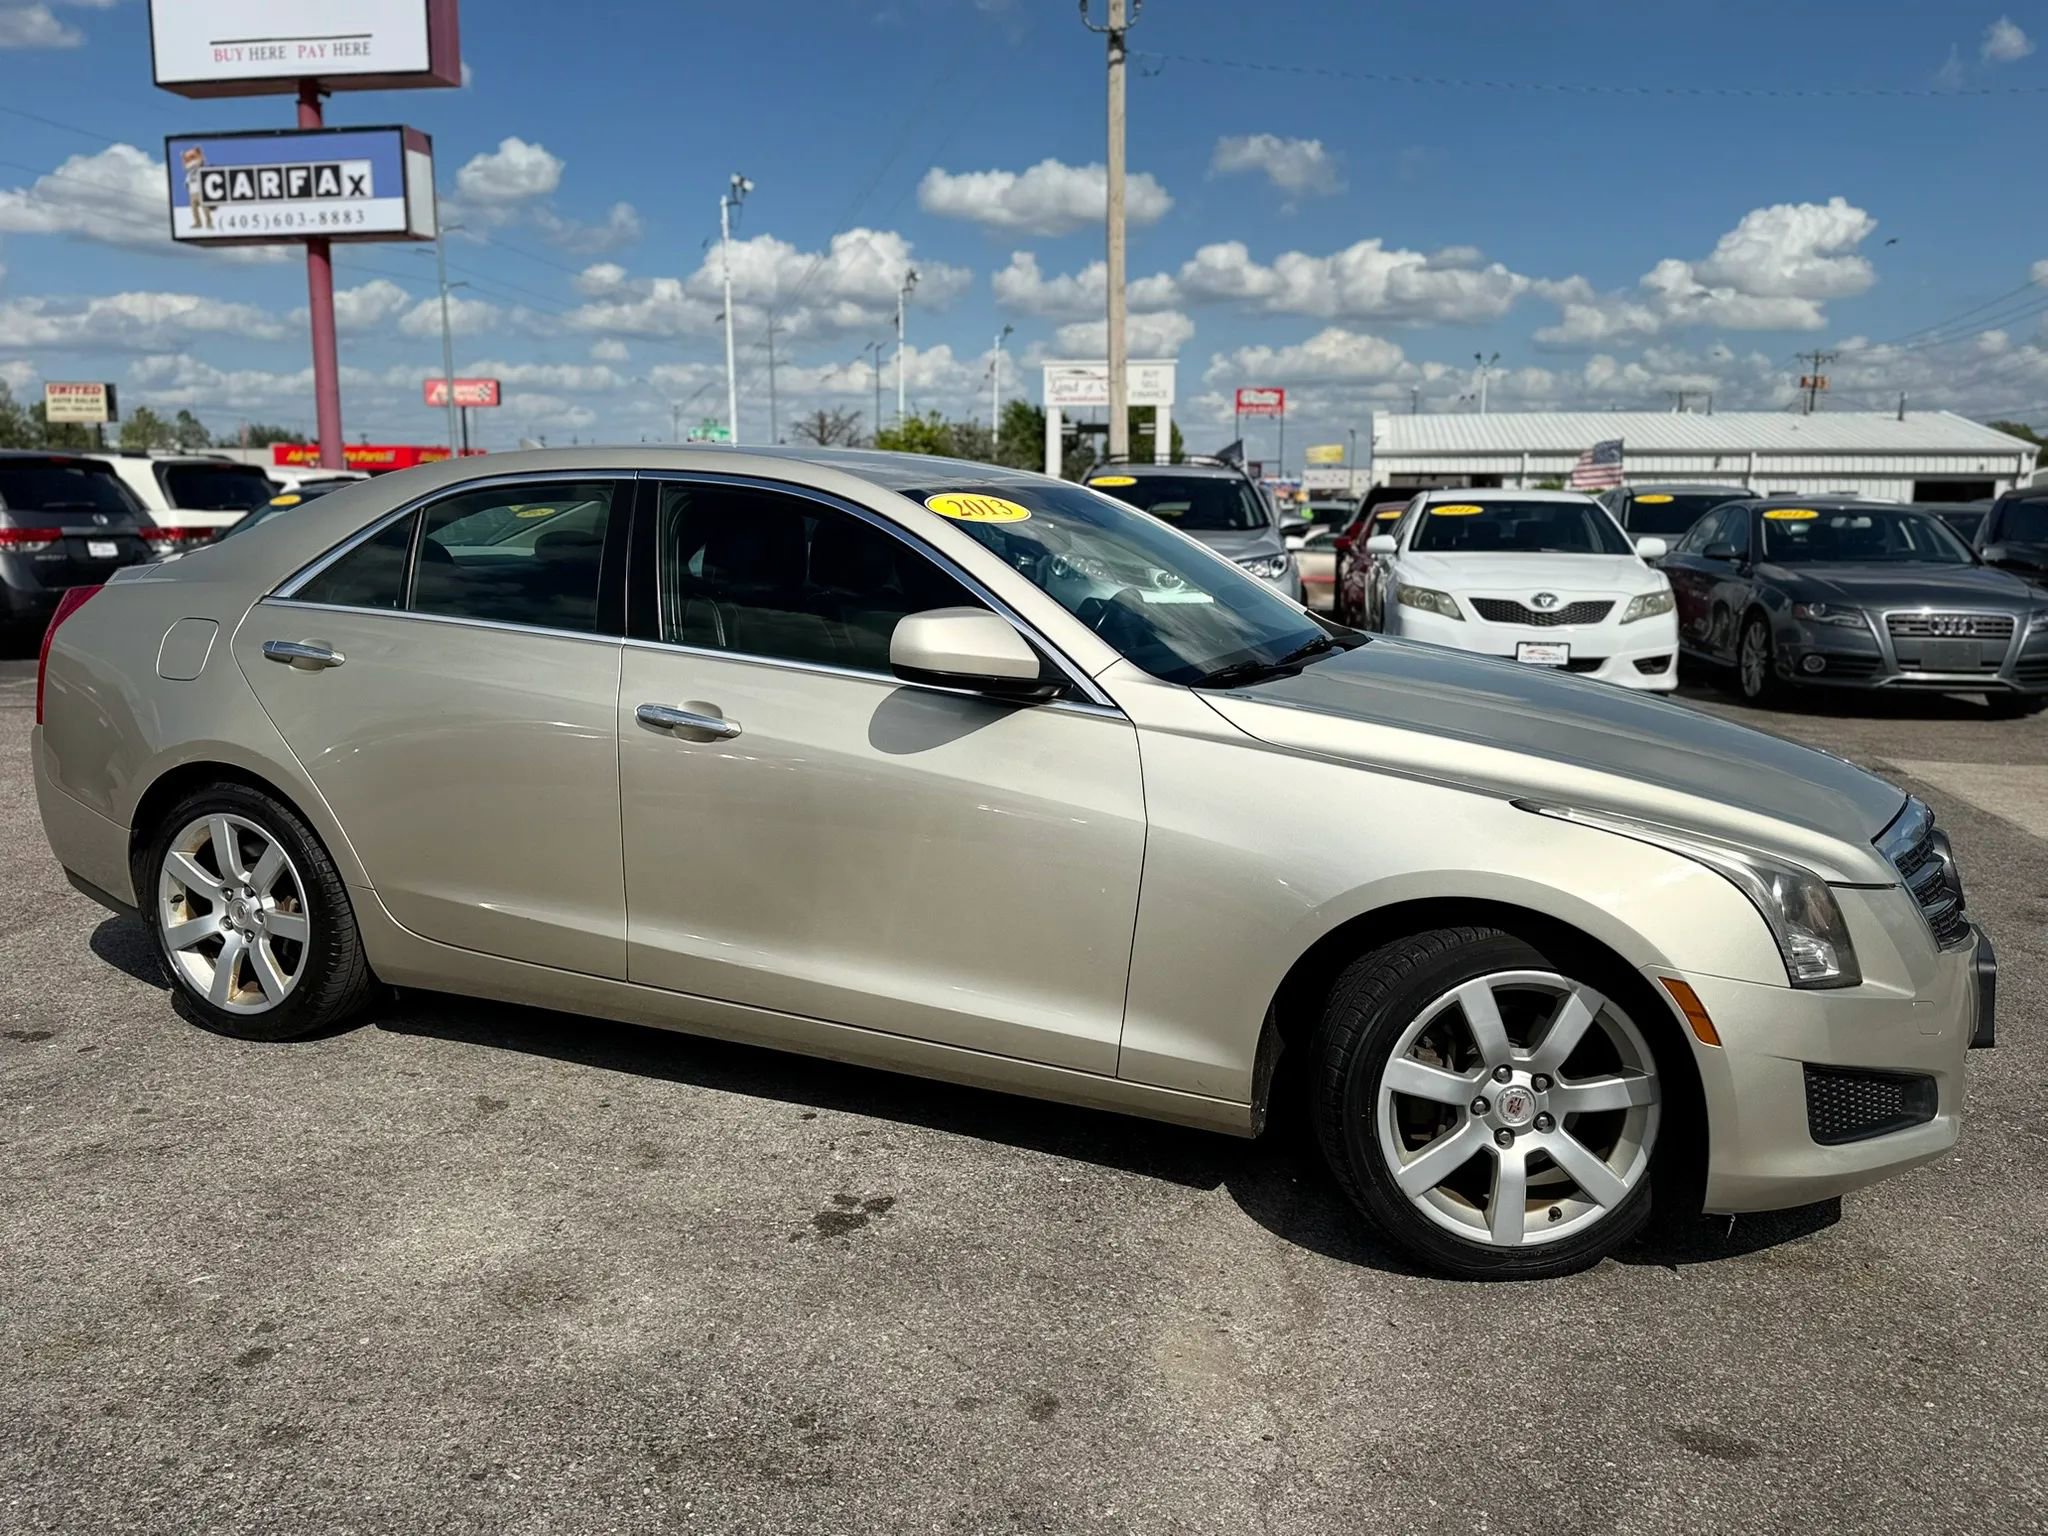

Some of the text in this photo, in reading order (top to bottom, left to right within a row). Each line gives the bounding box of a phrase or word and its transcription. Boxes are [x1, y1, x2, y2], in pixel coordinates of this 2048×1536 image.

[214, 41, 372, 62] BUY HERE PAY HERE
[204, 168, 366, 199] CARFAX
[218, 209, 366, 231] (405)603-8883
[947, 499, 1013, 516] 2013
